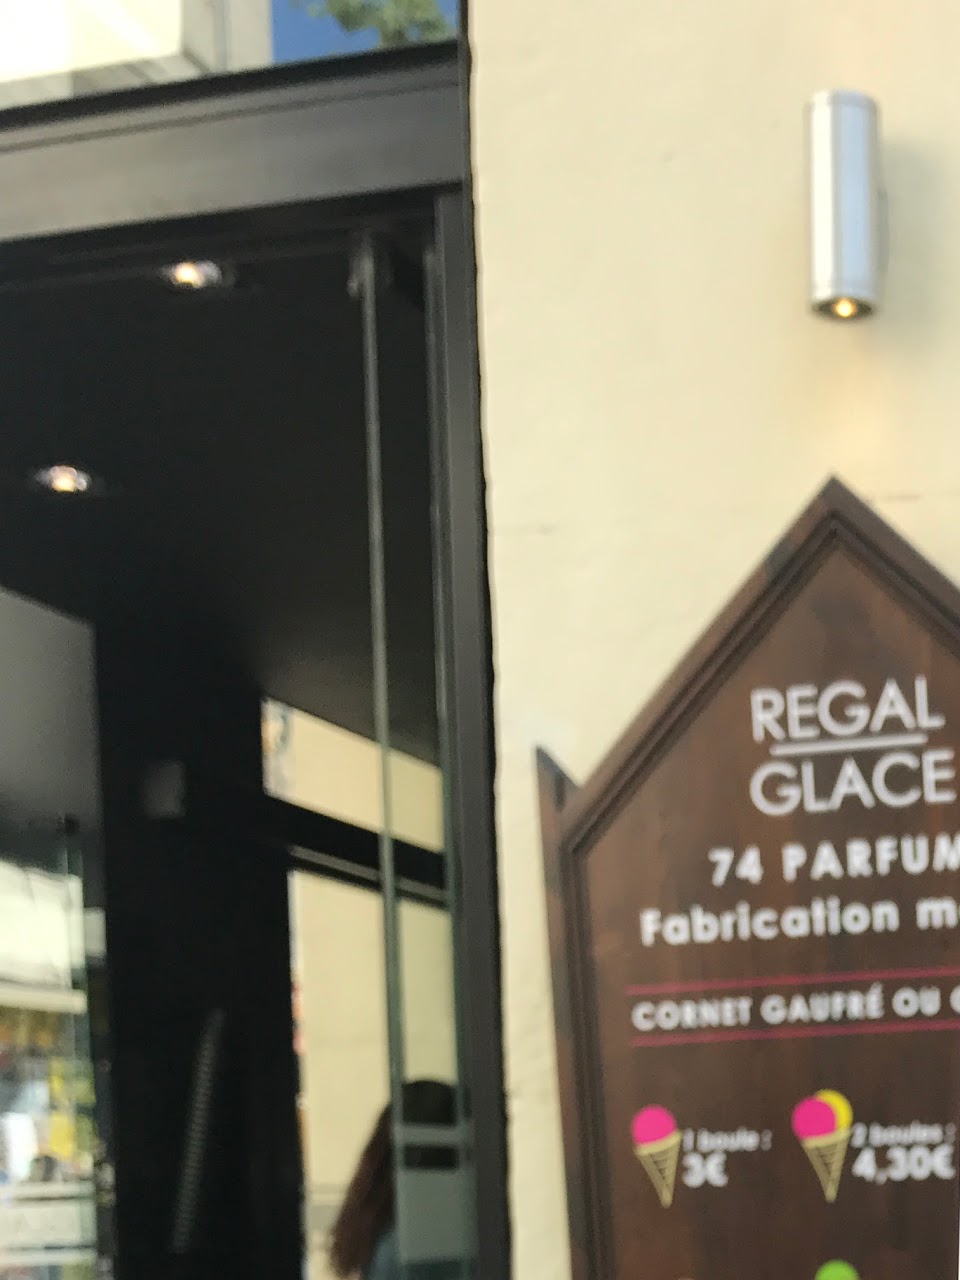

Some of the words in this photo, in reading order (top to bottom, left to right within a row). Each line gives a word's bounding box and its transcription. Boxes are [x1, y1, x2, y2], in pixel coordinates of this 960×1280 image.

[750, 675, 946, 744] REGAL
[749, 748, 958, 818] GLACE
[708, 845, 765, 887] 74
[638, 896, 900, 947] Fabrication
[631, 996, 753, 1032] CORNET
[760, 983, 885, 1025] GAUFRÉ
[892, 986, 942, 1018] OU
[682, 1150, 729, 1188] 3€
[852, 1145, 956, 1185] 4,30€
